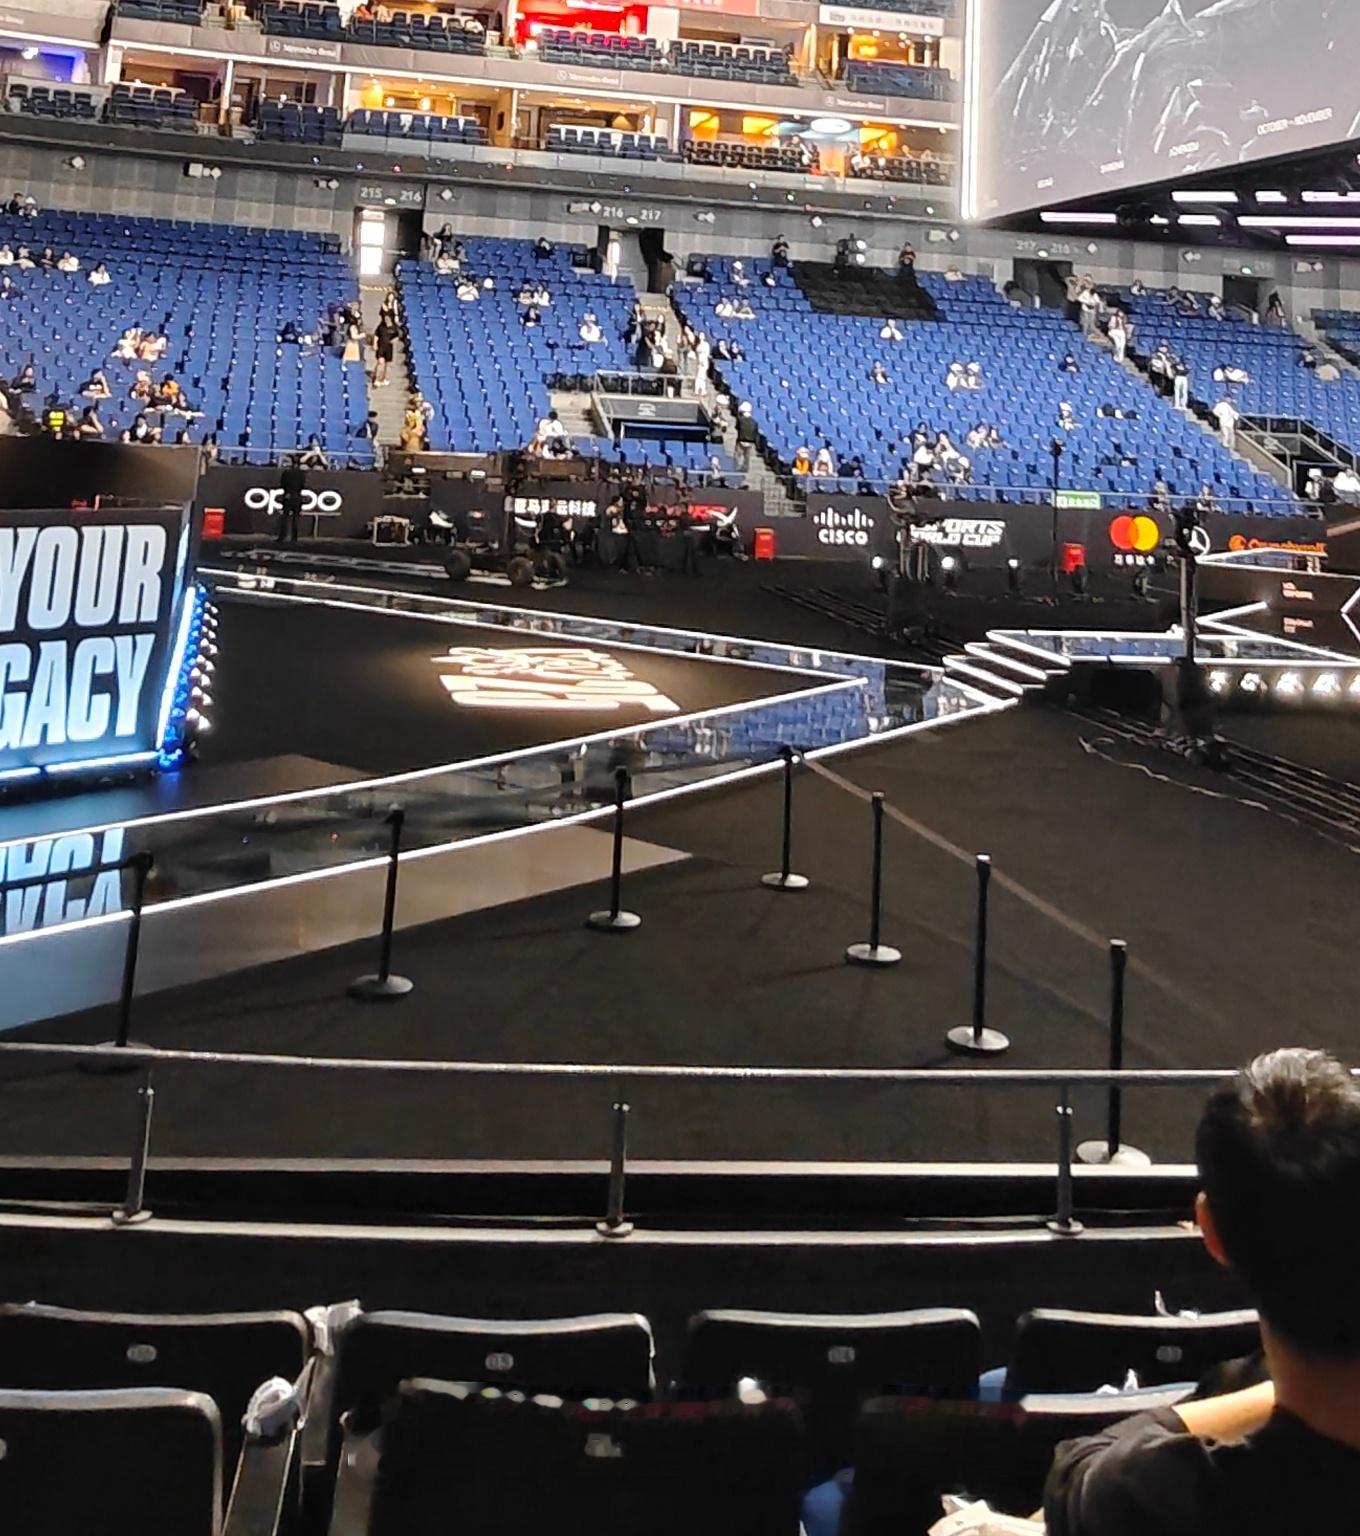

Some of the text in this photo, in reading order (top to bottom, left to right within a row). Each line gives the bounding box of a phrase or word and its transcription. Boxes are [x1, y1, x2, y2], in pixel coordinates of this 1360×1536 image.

[360, 186, 423, 202] 215 216
[603, 206, 661, 221] 216 217
[818, 528, 868, 545] CISCO
[962, 533, 1002, 547] CUP
